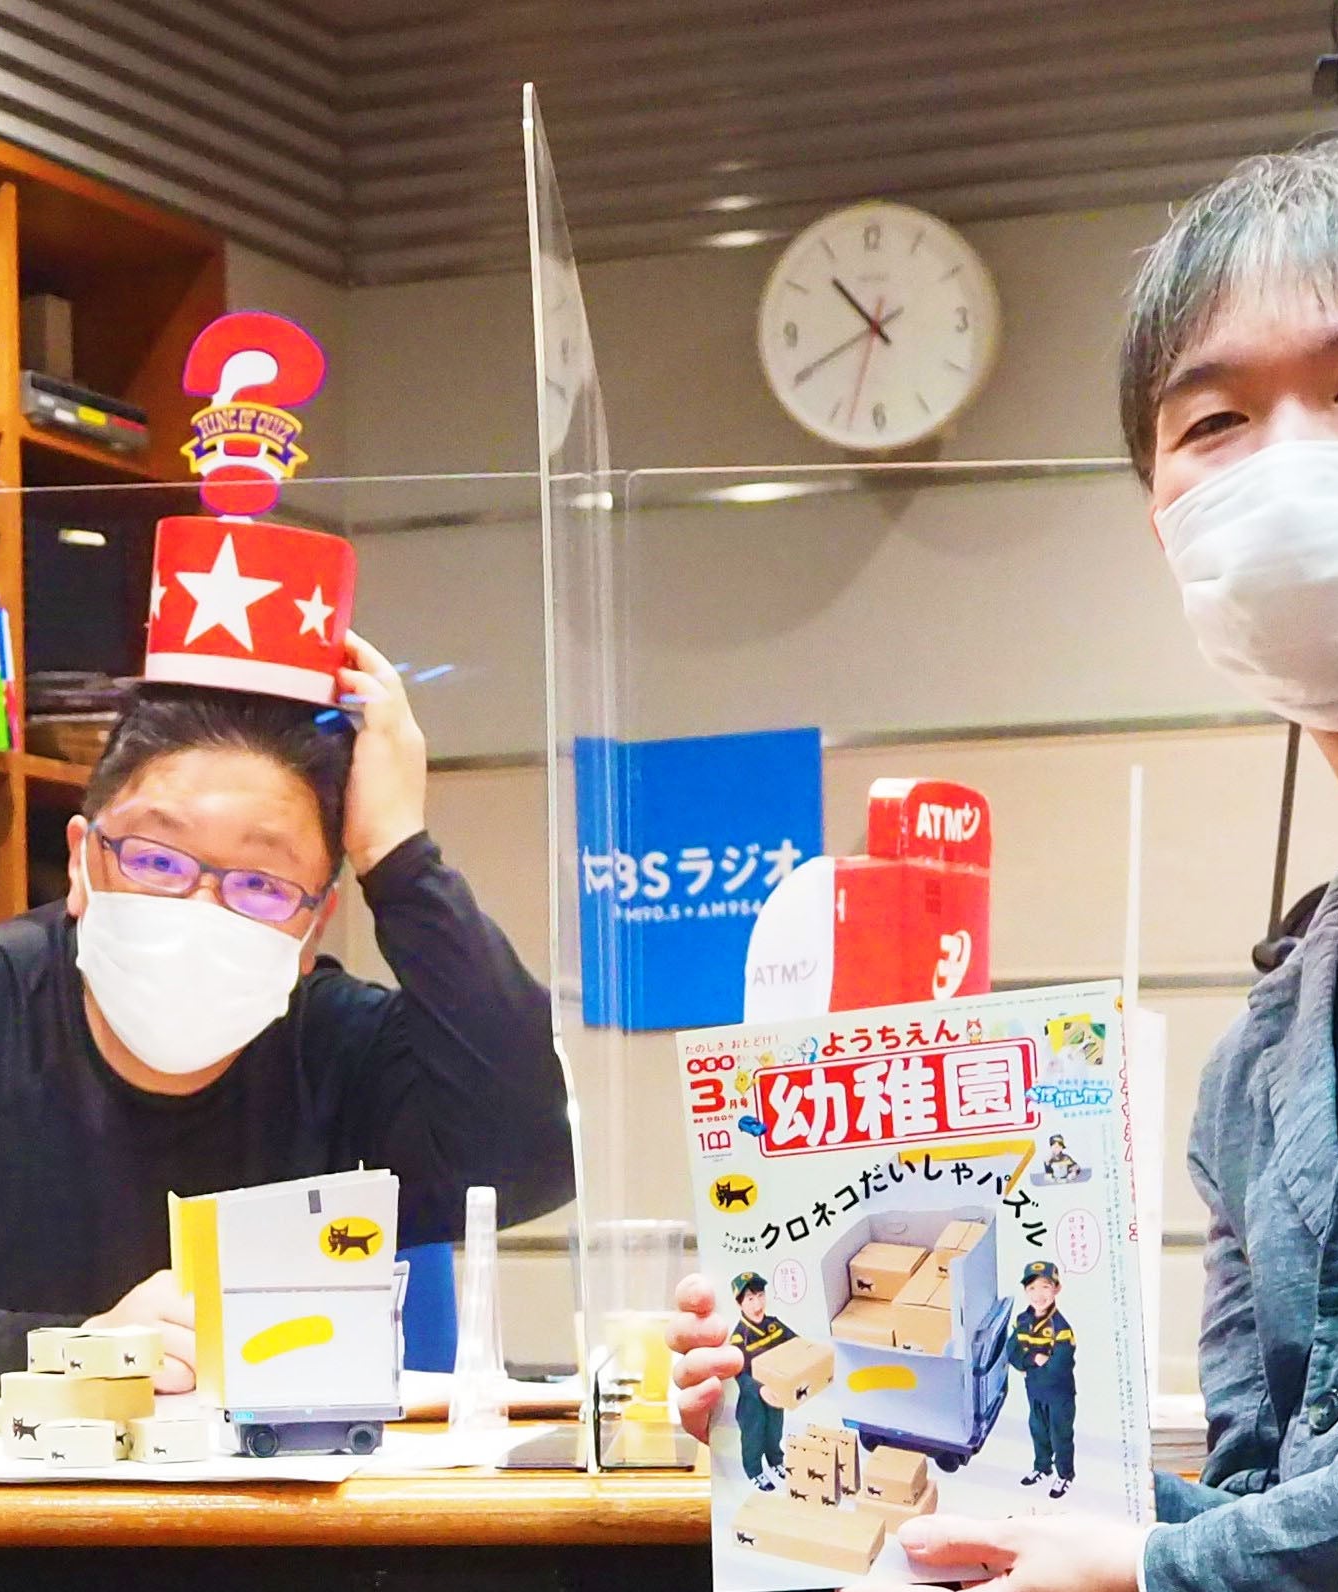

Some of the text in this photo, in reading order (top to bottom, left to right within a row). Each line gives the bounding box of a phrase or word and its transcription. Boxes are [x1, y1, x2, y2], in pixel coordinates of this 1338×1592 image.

[955, 306, 969, 333] 3
[821, 1018, 961, 1057] ようちえん
[689, 1078, 749, 1114] 3月号
[768, 1045, 1028, 1147] 幼稚園
[760, 1153, 1048, 1250] クロネコだいしゃパズル
